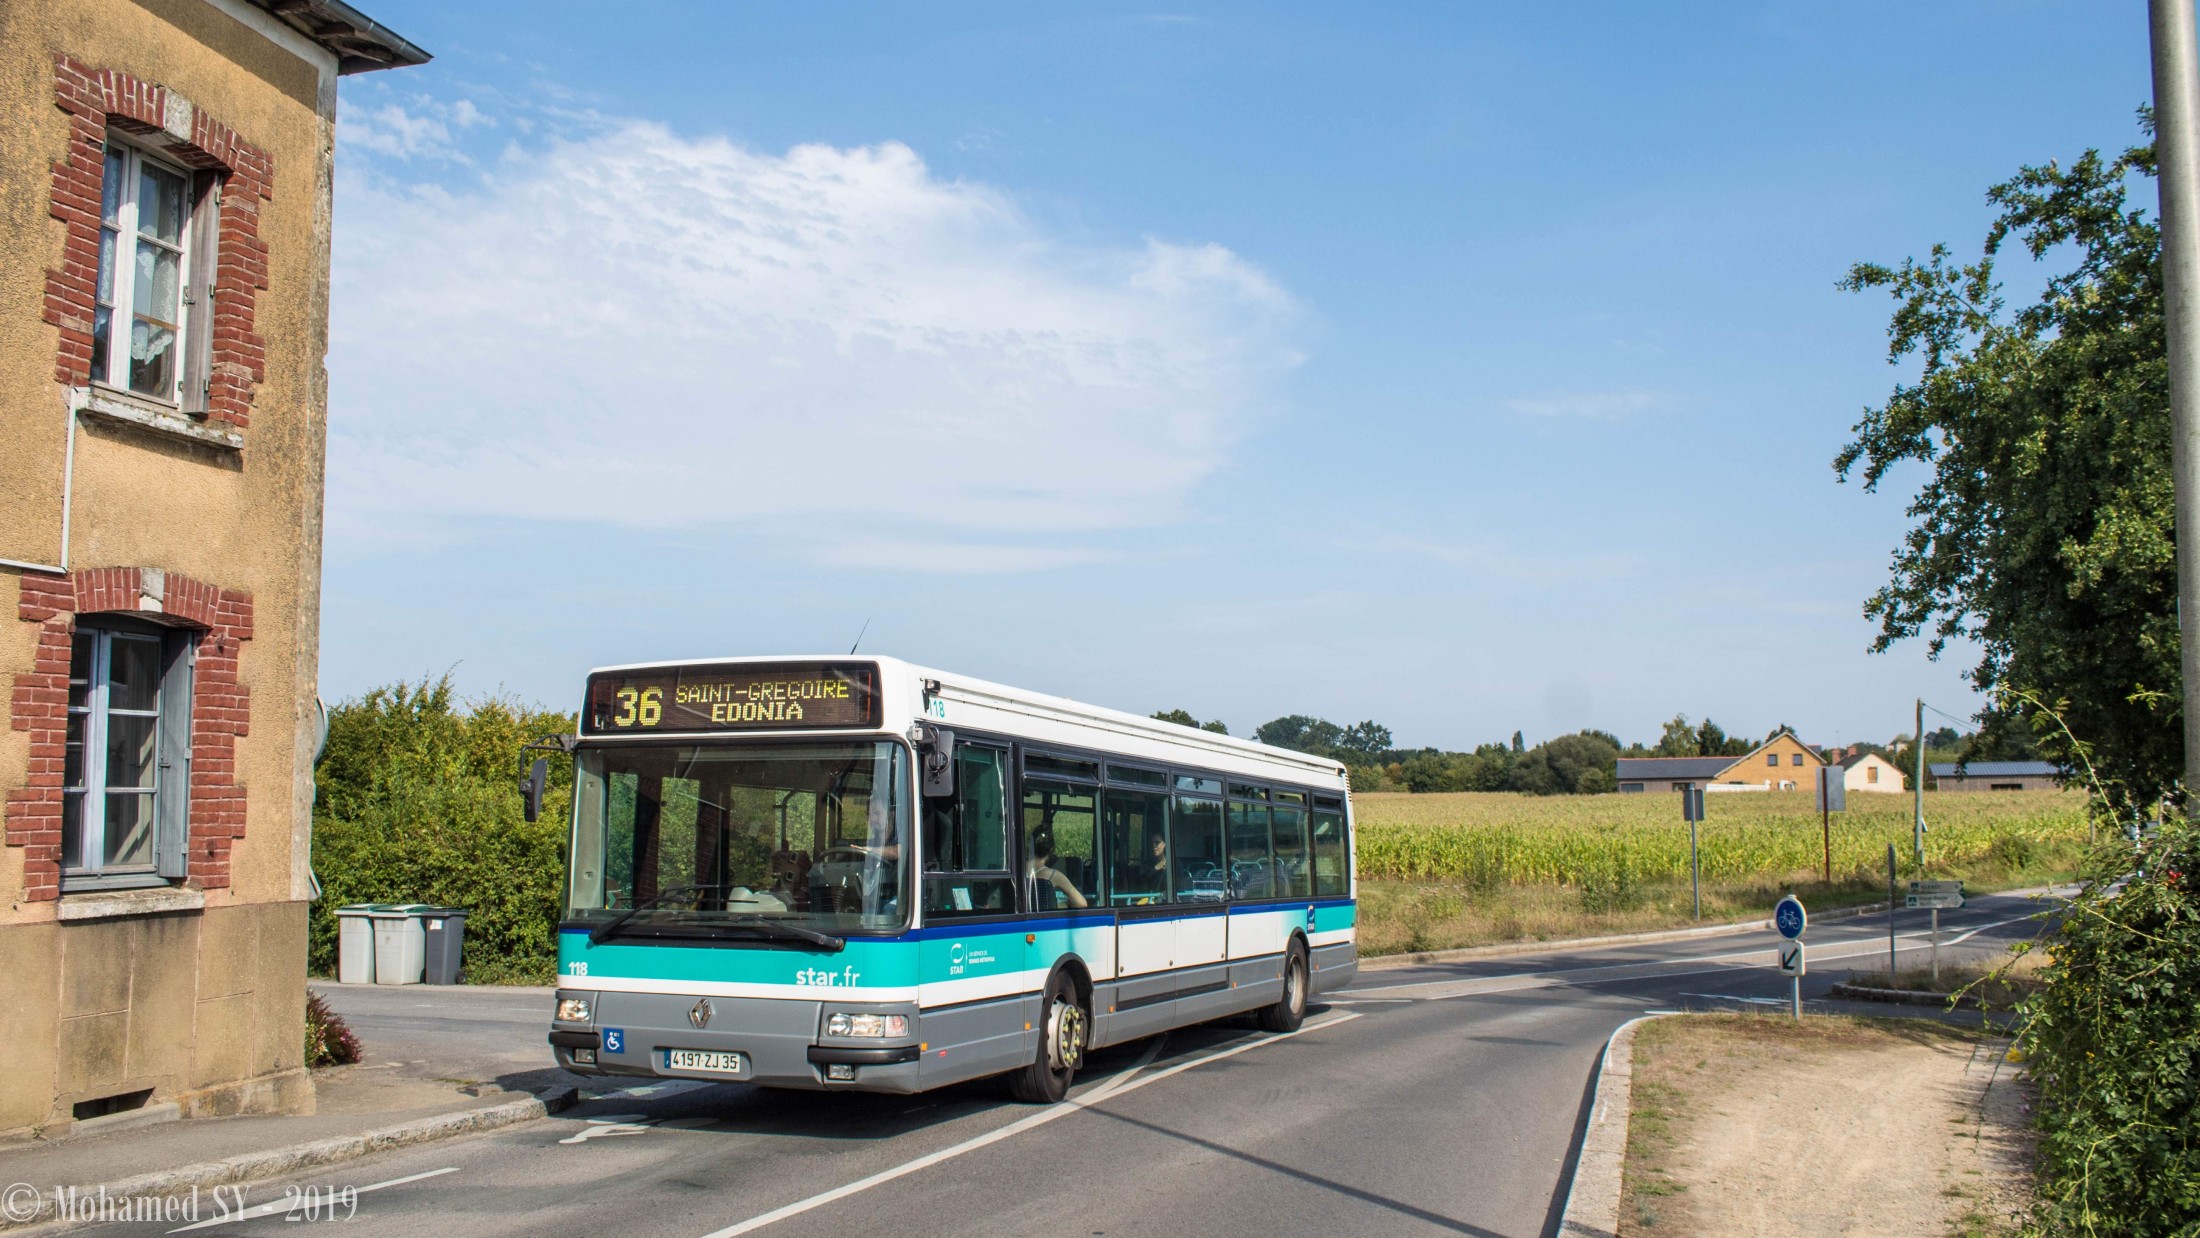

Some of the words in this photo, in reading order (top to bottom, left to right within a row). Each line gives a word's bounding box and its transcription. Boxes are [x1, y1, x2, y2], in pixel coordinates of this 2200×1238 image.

[675, 679, 850, 704] SAINT-GREGOIRE
[614, 686, 663, 727] 36
[711, 700, 804, 722] EDONIA
[568, 961, 589, 976] 118
[795, 965, 861, 988] star.fr
[950, 965, 964, 975] STAR
[673, 1052, 701, 1067] 4197
[704, 1054, 719, 1069] ZJ
[722, 1055, 738, 1069] 35
